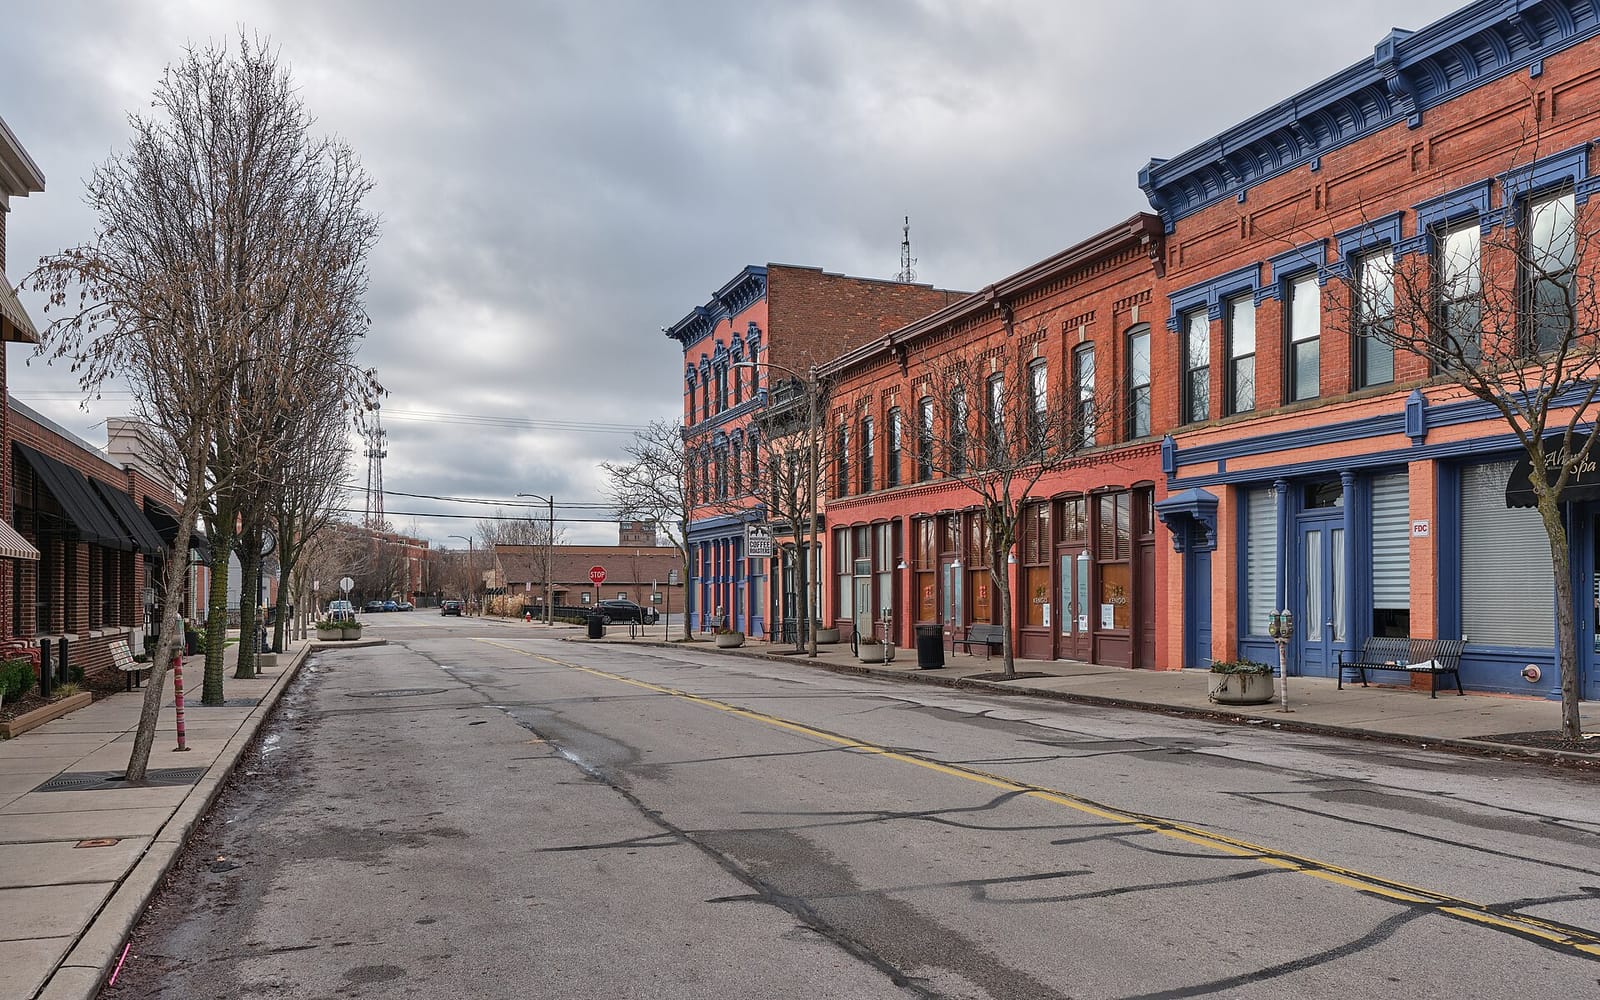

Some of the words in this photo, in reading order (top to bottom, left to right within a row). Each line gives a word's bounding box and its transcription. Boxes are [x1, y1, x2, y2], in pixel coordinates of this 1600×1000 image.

[1414, 524, 1428, 533] FDC
[750, 540, 771, 548] COFFEE
[590, 571, 605, 579] STOP
